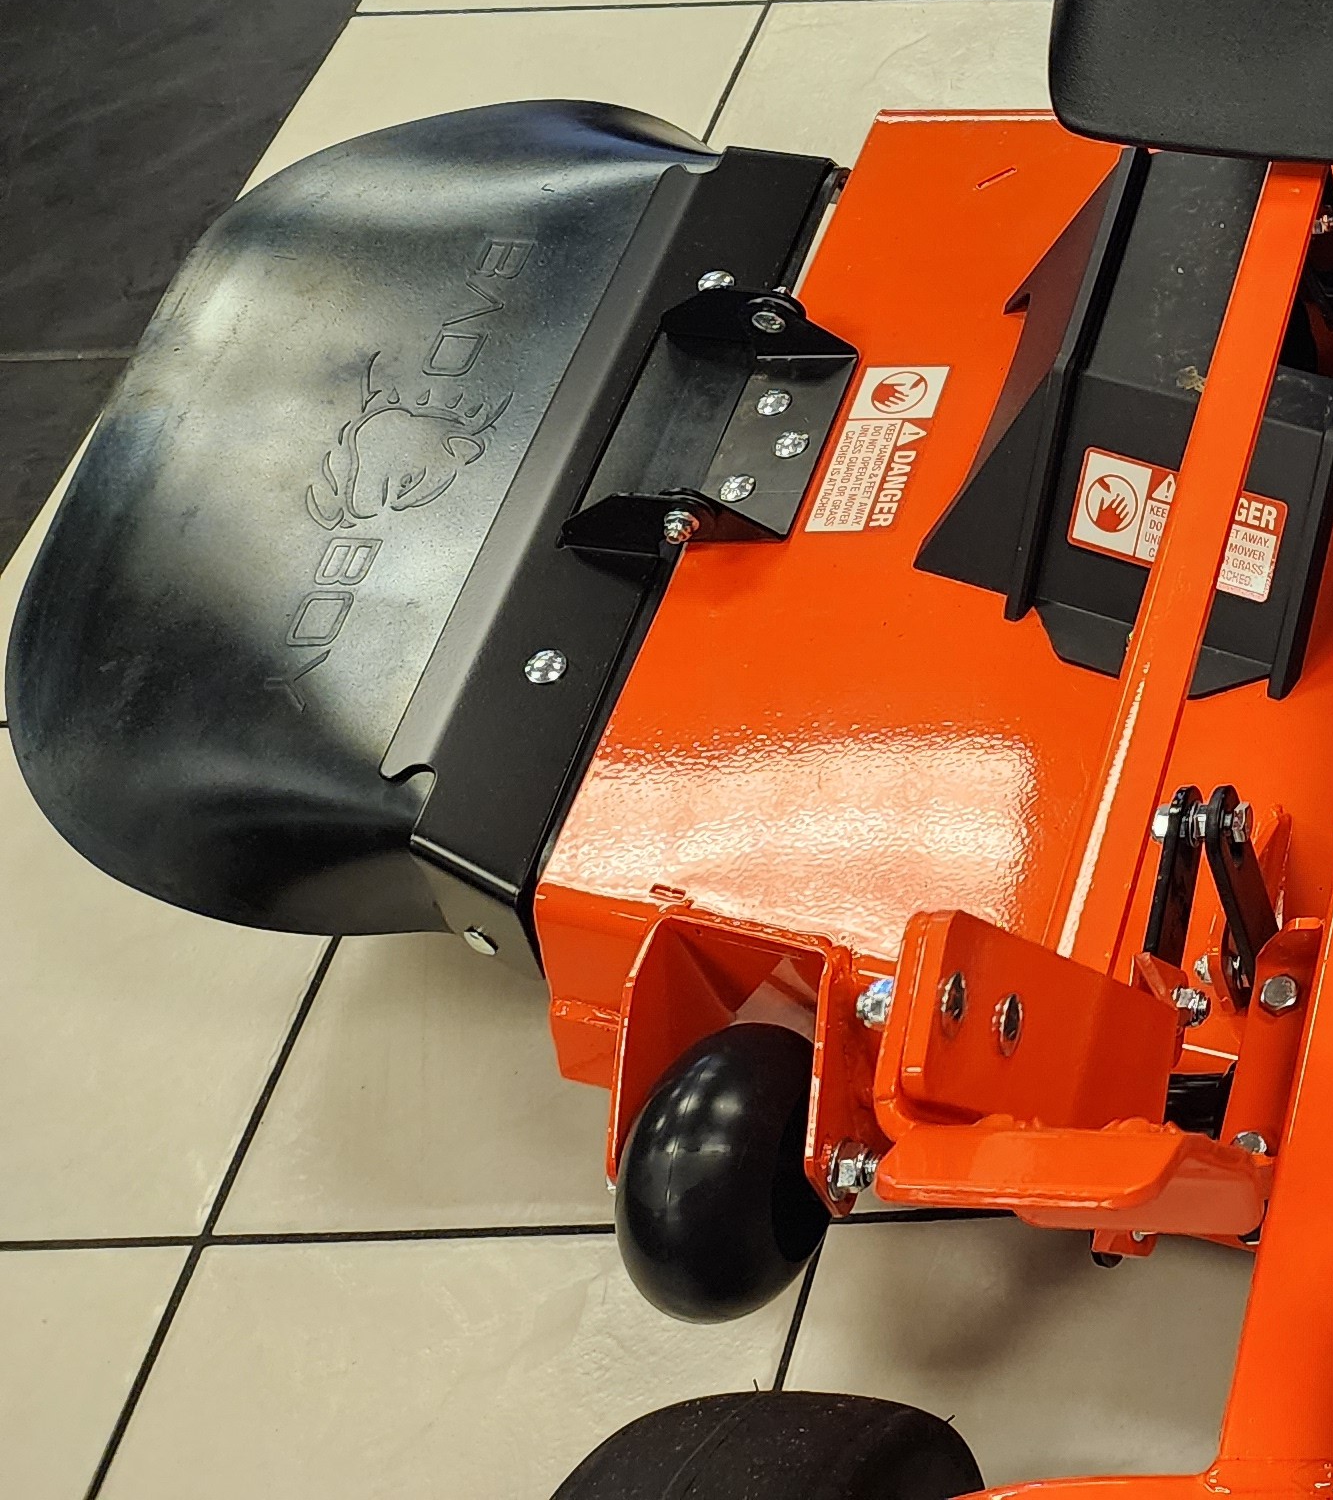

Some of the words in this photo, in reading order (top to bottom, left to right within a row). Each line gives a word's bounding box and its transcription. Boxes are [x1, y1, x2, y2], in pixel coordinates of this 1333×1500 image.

[421, 236, 535, 378] BAD
[852, 424, 871, 454] UNLESS
[871, 426, 883, 437] DO
[884, 423, 898, 442] KEEP
[835, 430, 856, 466] CATCHER
[865, 438, 879, 454] NOT
[872, 444, 890, 472] HANDS
[830, 468, 840, 476] IS
[841, 457, 858, 484] GUARD
[850, 456, 871, 491] OPERATE
[836, 485, 848, 497] OR
[862, 481, 876, 500] FEET
[869, 450, 917, 527] DANGER
[824, 500, 842, 526] GRASS
[838, 494, 859, 525] MOWER
[851, 502, 868, 526] AWAY.
[1234, 497, 1278, 531] GER
[1149, 504, 1167, 519] KEE
[1241, 532, 1270, 548] AWAY.
[1149, 519, 1163, 531] DO
[1228, 542, 1266, 561] MOWER
[1231, 558, 1264, 576] GRASS
[263, 537, 383, 713] BOY
